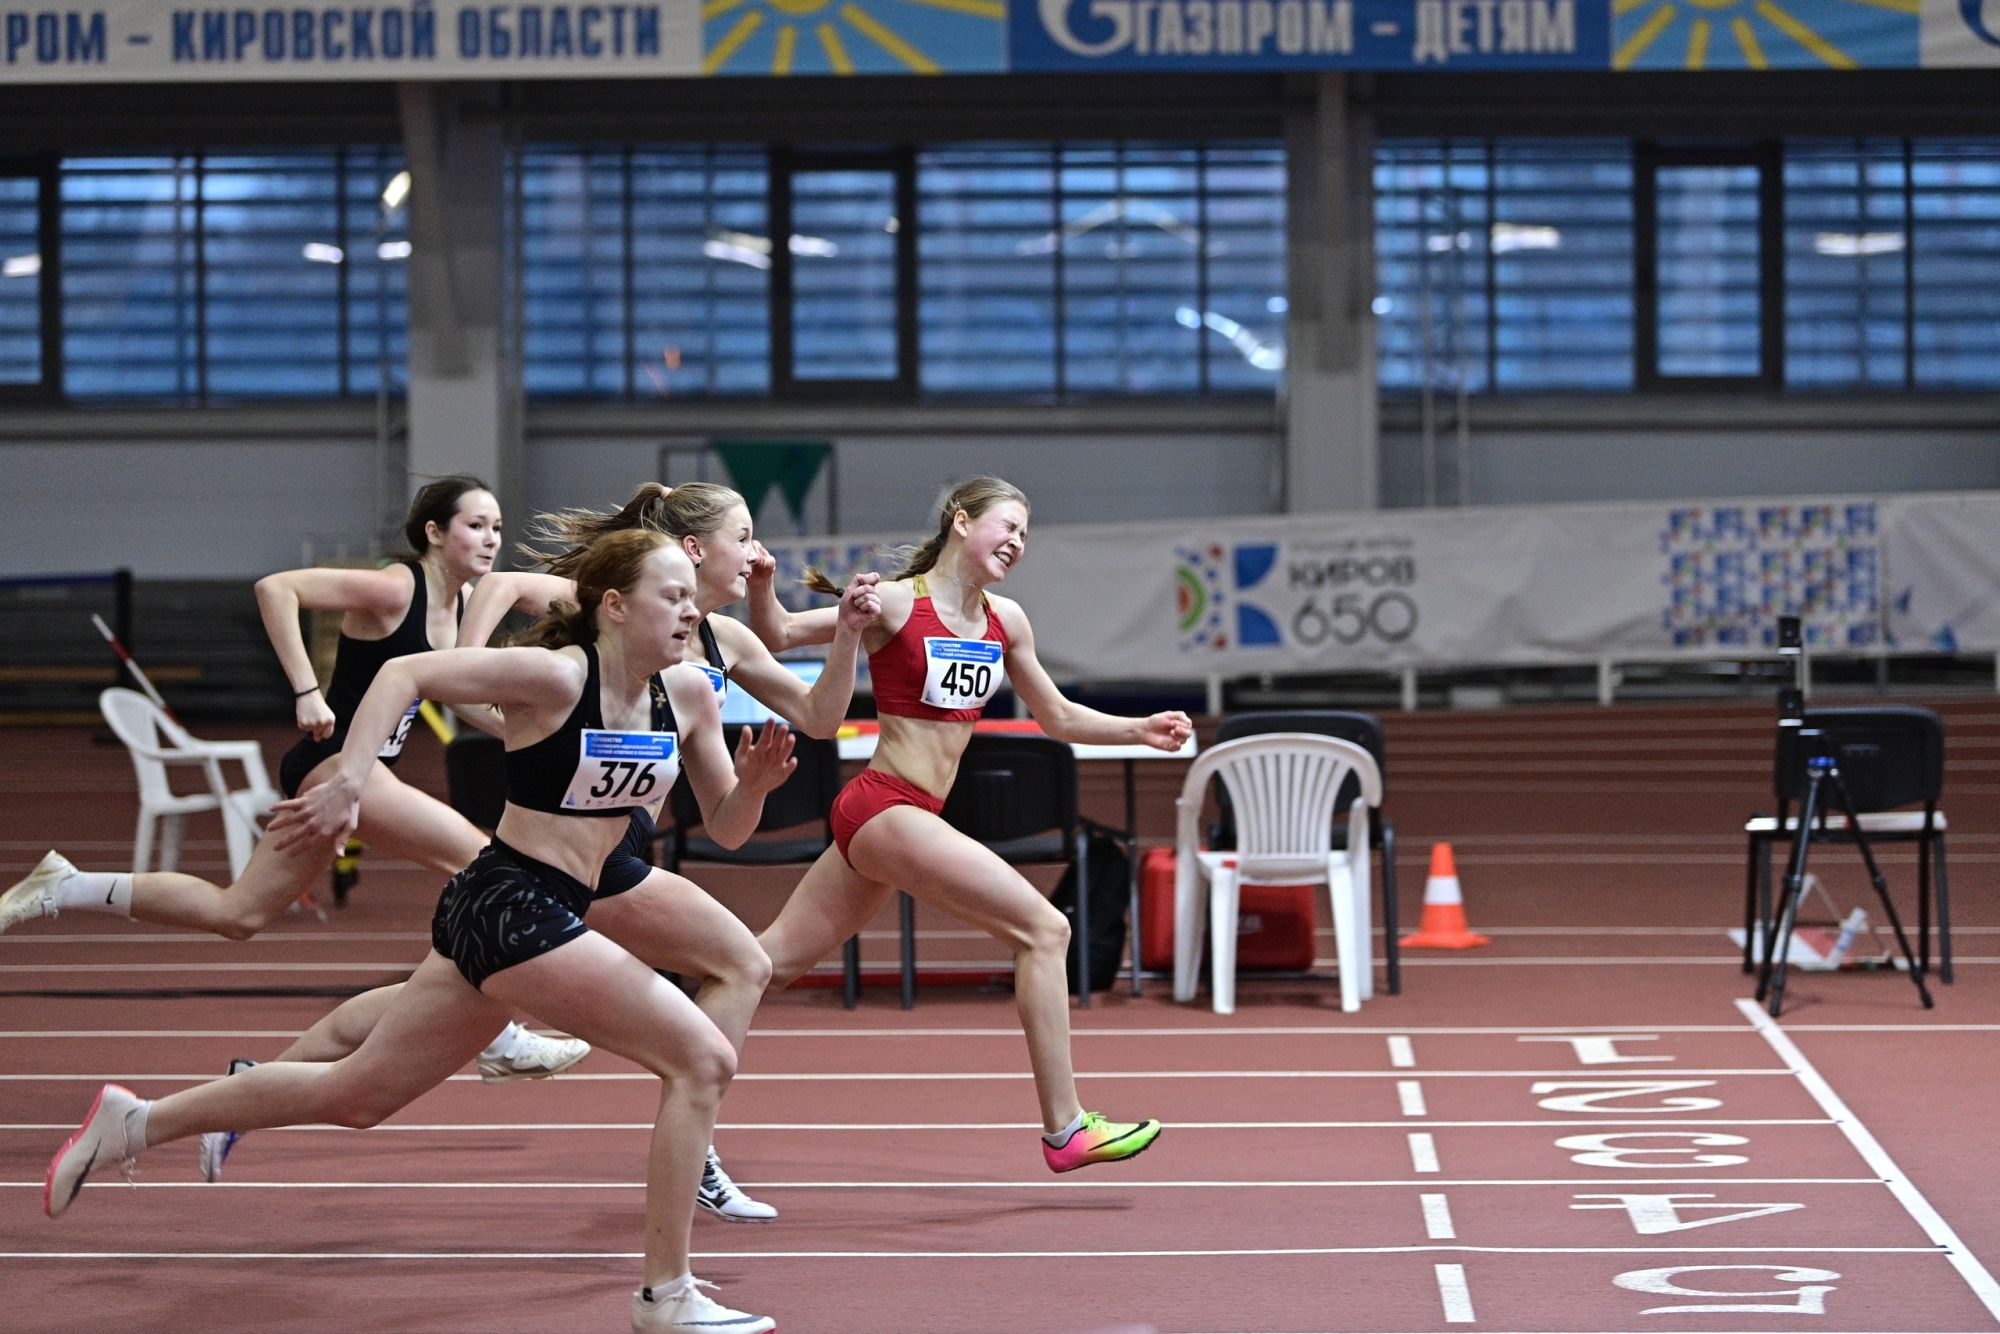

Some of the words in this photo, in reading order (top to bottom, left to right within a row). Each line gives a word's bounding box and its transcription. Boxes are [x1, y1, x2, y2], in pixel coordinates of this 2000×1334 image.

[5, 10, 107, 63] РОМ
[171, 0, 438, 61] КИРОВСКОЙ
[457, 3, 661, 60] ОБЛАСТИ
[1134, 0, 1353, 56] ГАЗПРОМ
[1412, 0, 1576, 62] ДЕТЯМ
[1292, 591, 1418, 647] 650
[940, 661, 991, 698] 450
[590, 760, 657, 799] 376
[1516, 1034, 1676, 1066] 1
[1530, 1080, 1724, 1114] 2
[1554, 1131, 1750, 1169] 3
[1568, 1193, 1806, 1235] 4
[1612, 1264, 1842, 1316] 5
